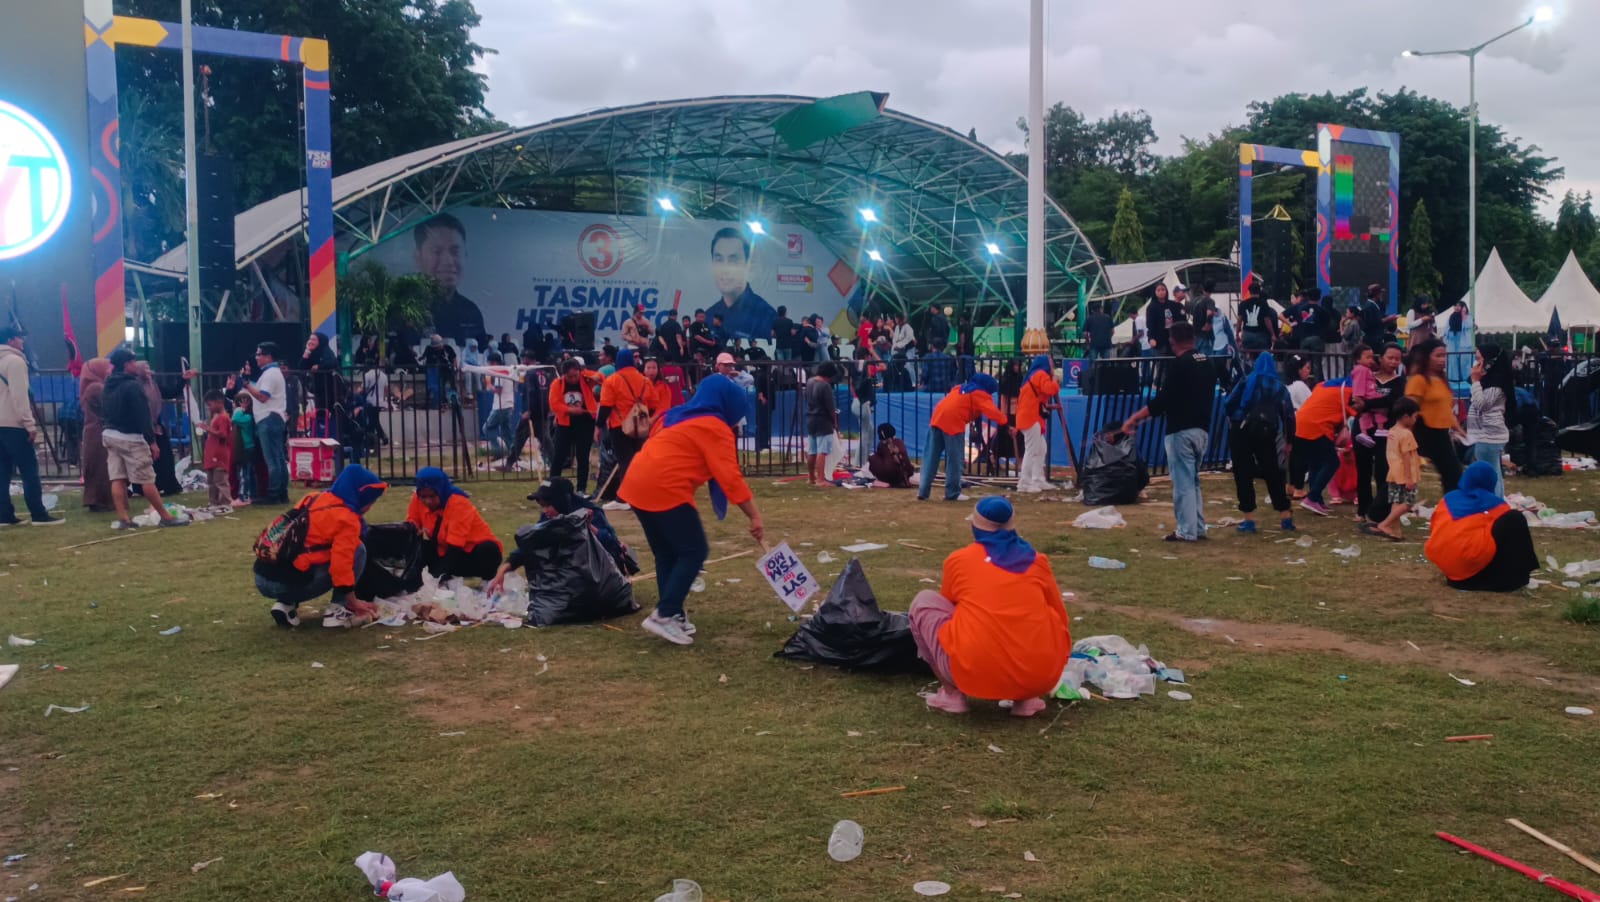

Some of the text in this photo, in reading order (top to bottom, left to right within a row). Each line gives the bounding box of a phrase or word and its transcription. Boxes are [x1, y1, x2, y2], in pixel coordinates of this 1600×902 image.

[589, 230, 614, 270] 3
[533, 285, 660, 309] TASMING
[769, 555, 798, 583] TSM
[782, 572, 808, 597] SYT
